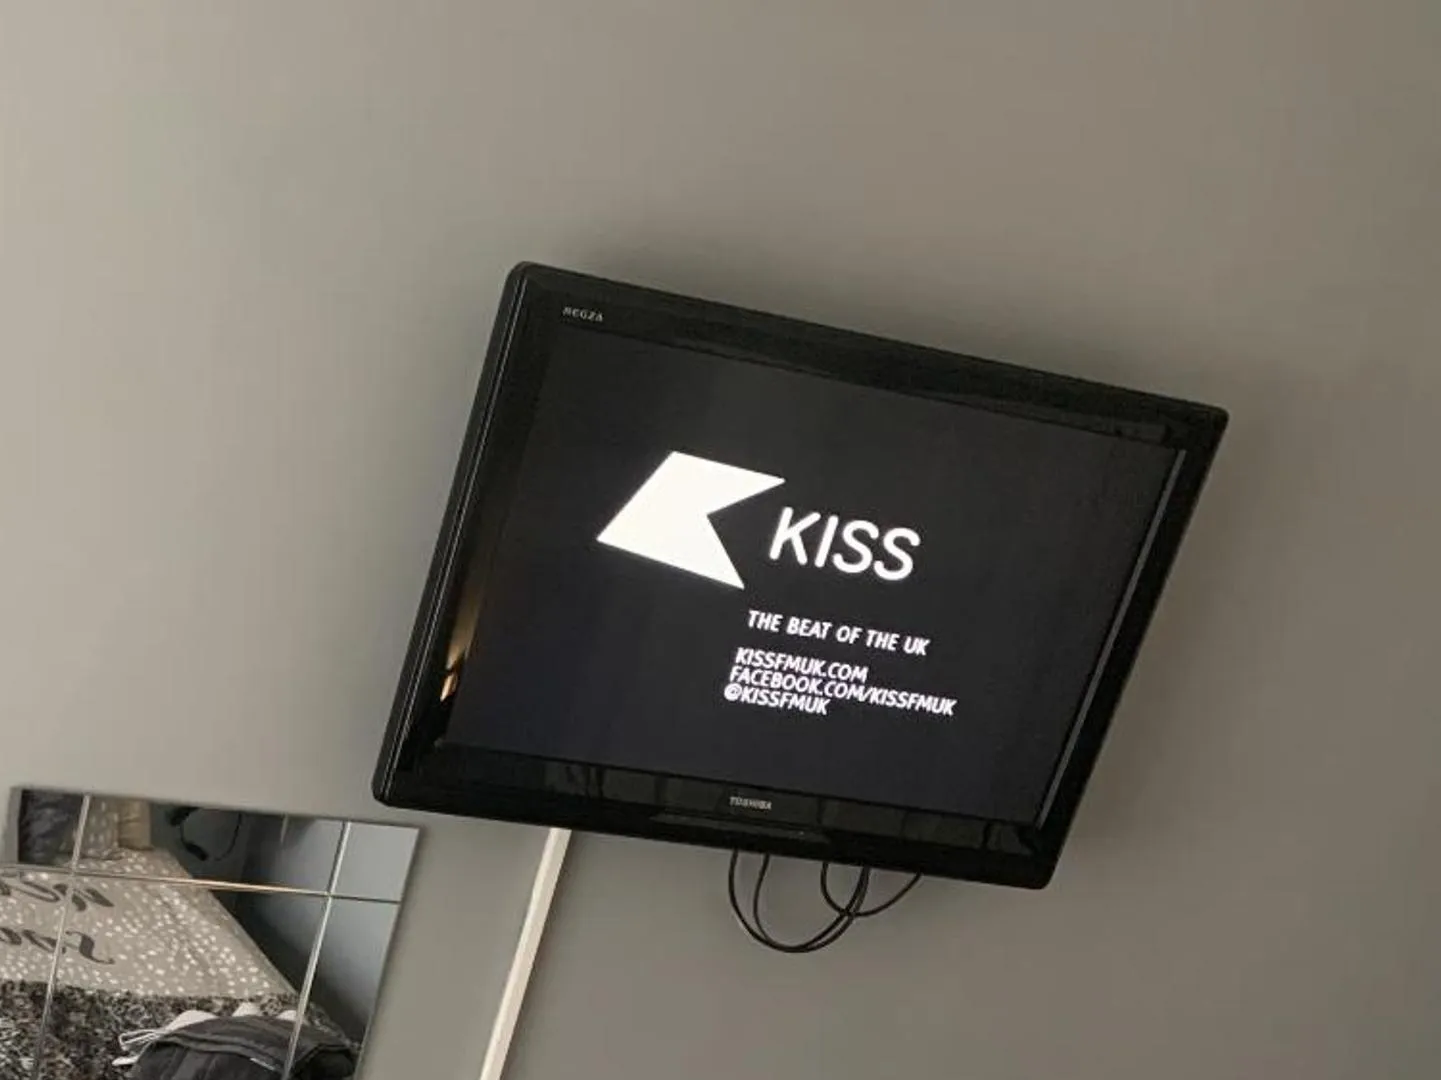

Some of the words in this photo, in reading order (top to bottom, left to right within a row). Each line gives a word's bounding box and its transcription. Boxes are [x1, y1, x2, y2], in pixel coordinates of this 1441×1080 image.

[769, 506, 921, 581] KISS
[748, 609, 783, 632] THE
[786, 616, 833, 639] BEAT
[836, 625, 863, 644] OF
[865, 629, 901, 651] THE
[903, 636, 931, 656] UK
[735, 647, 869, 683] KISSFMUK.COM
[724, 682, 831, 715] @KISSFMUK
[729, 666, 958, 716] FACEBOOK.COM/KISSFMUK
